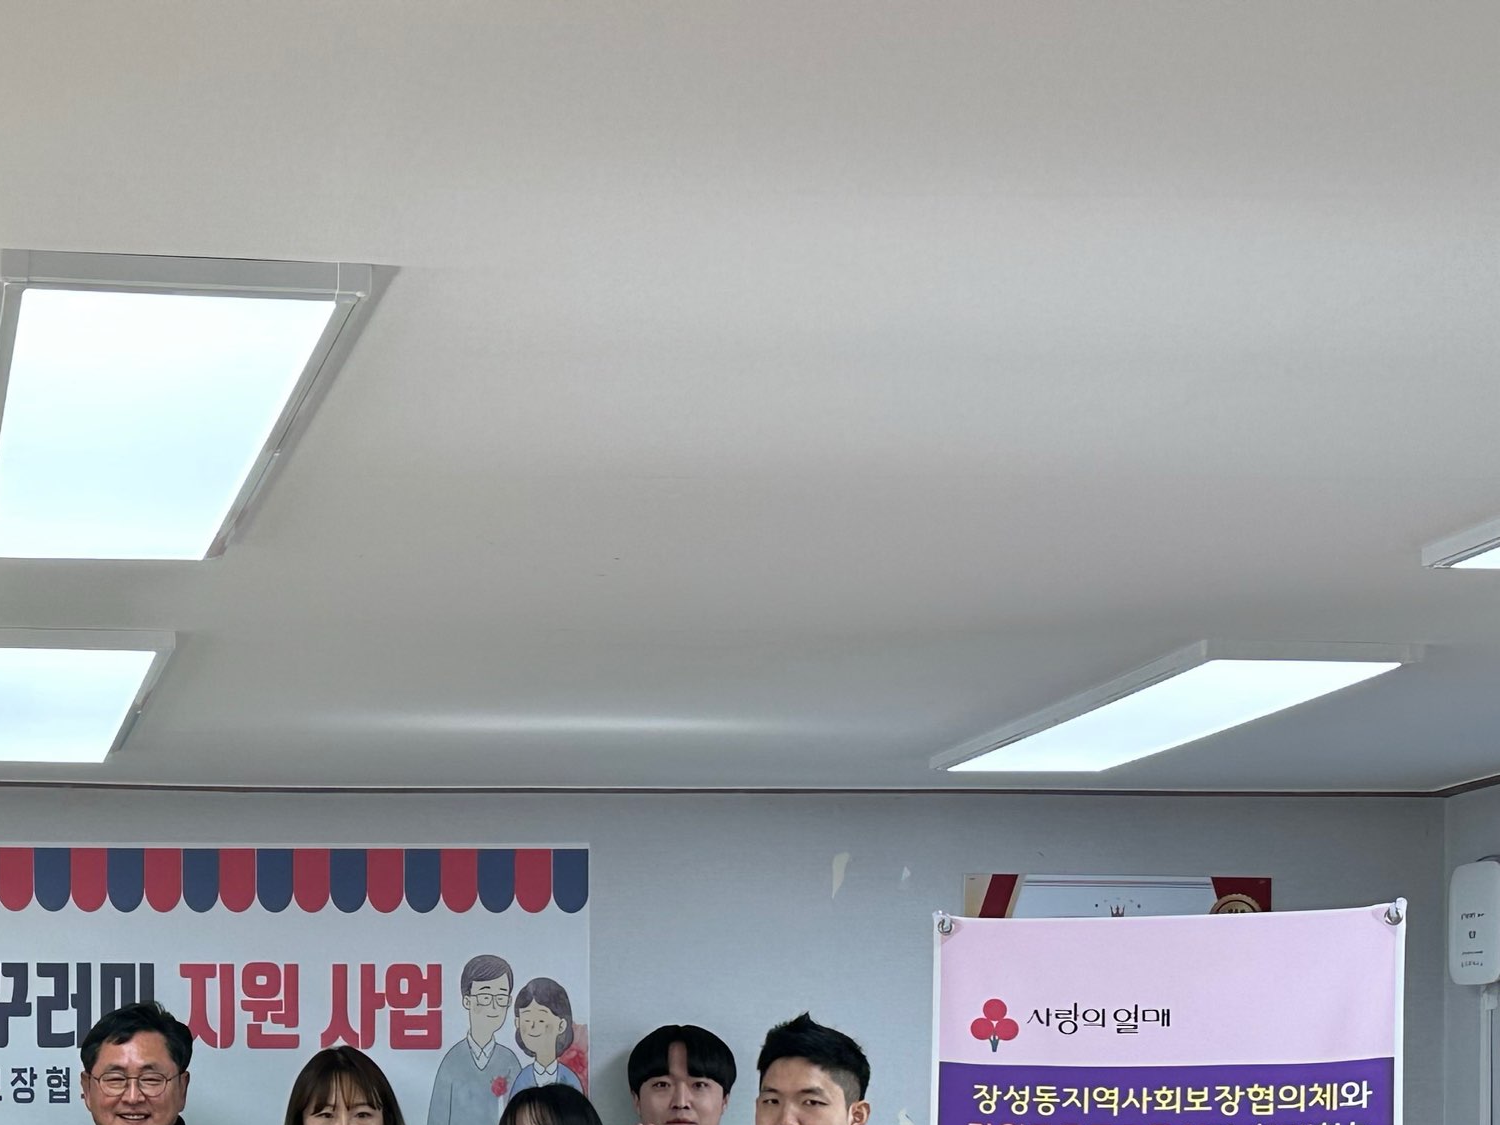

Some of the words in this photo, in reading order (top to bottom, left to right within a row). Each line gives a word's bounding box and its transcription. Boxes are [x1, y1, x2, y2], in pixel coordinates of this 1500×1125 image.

[179, 962, 300, 1049] 지원
[321, 963, 443, 1050] 사업
[1027, 1002, 1105, 1035] 사랑의
[1113, 1004, 1171, 1034] 열매
[972, 1080, 1372, 1116] 장성동지역사회보장협의체와
